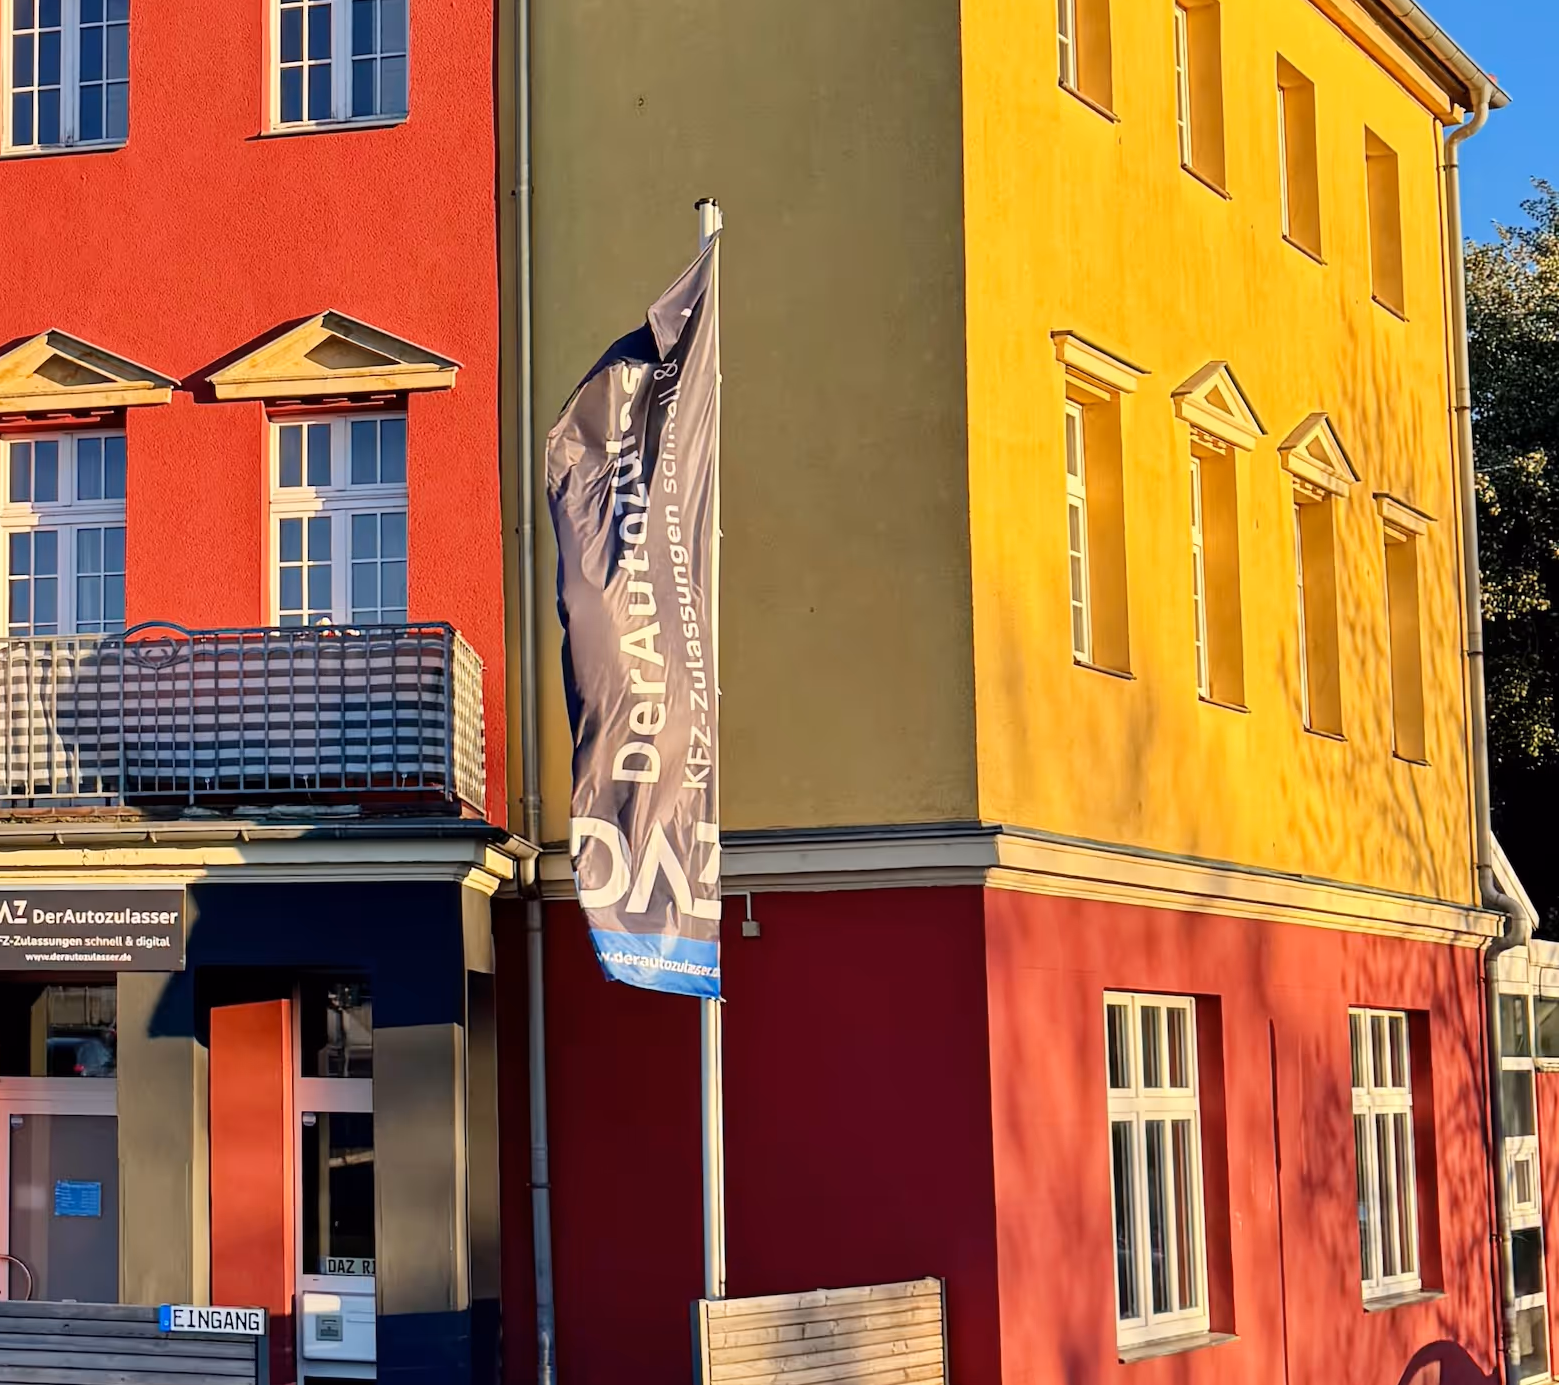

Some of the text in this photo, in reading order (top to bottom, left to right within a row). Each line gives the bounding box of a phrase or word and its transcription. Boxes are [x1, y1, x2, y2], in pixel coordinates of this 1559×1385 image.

[664, 505, 712, 789] KFZ-Zulassungen
[32, 908, 178, 925] DerAutozulasser
[85, 935, 123, 947] schnell
[125, 936, 133, 947] &
[136, 935, 170, 949] digital
[25, 952, 132, 963] www.derautozulasser.de
[328, 1259, 355, 1274] DAZ
[173, 1309, 260, 1331] EINGANG
